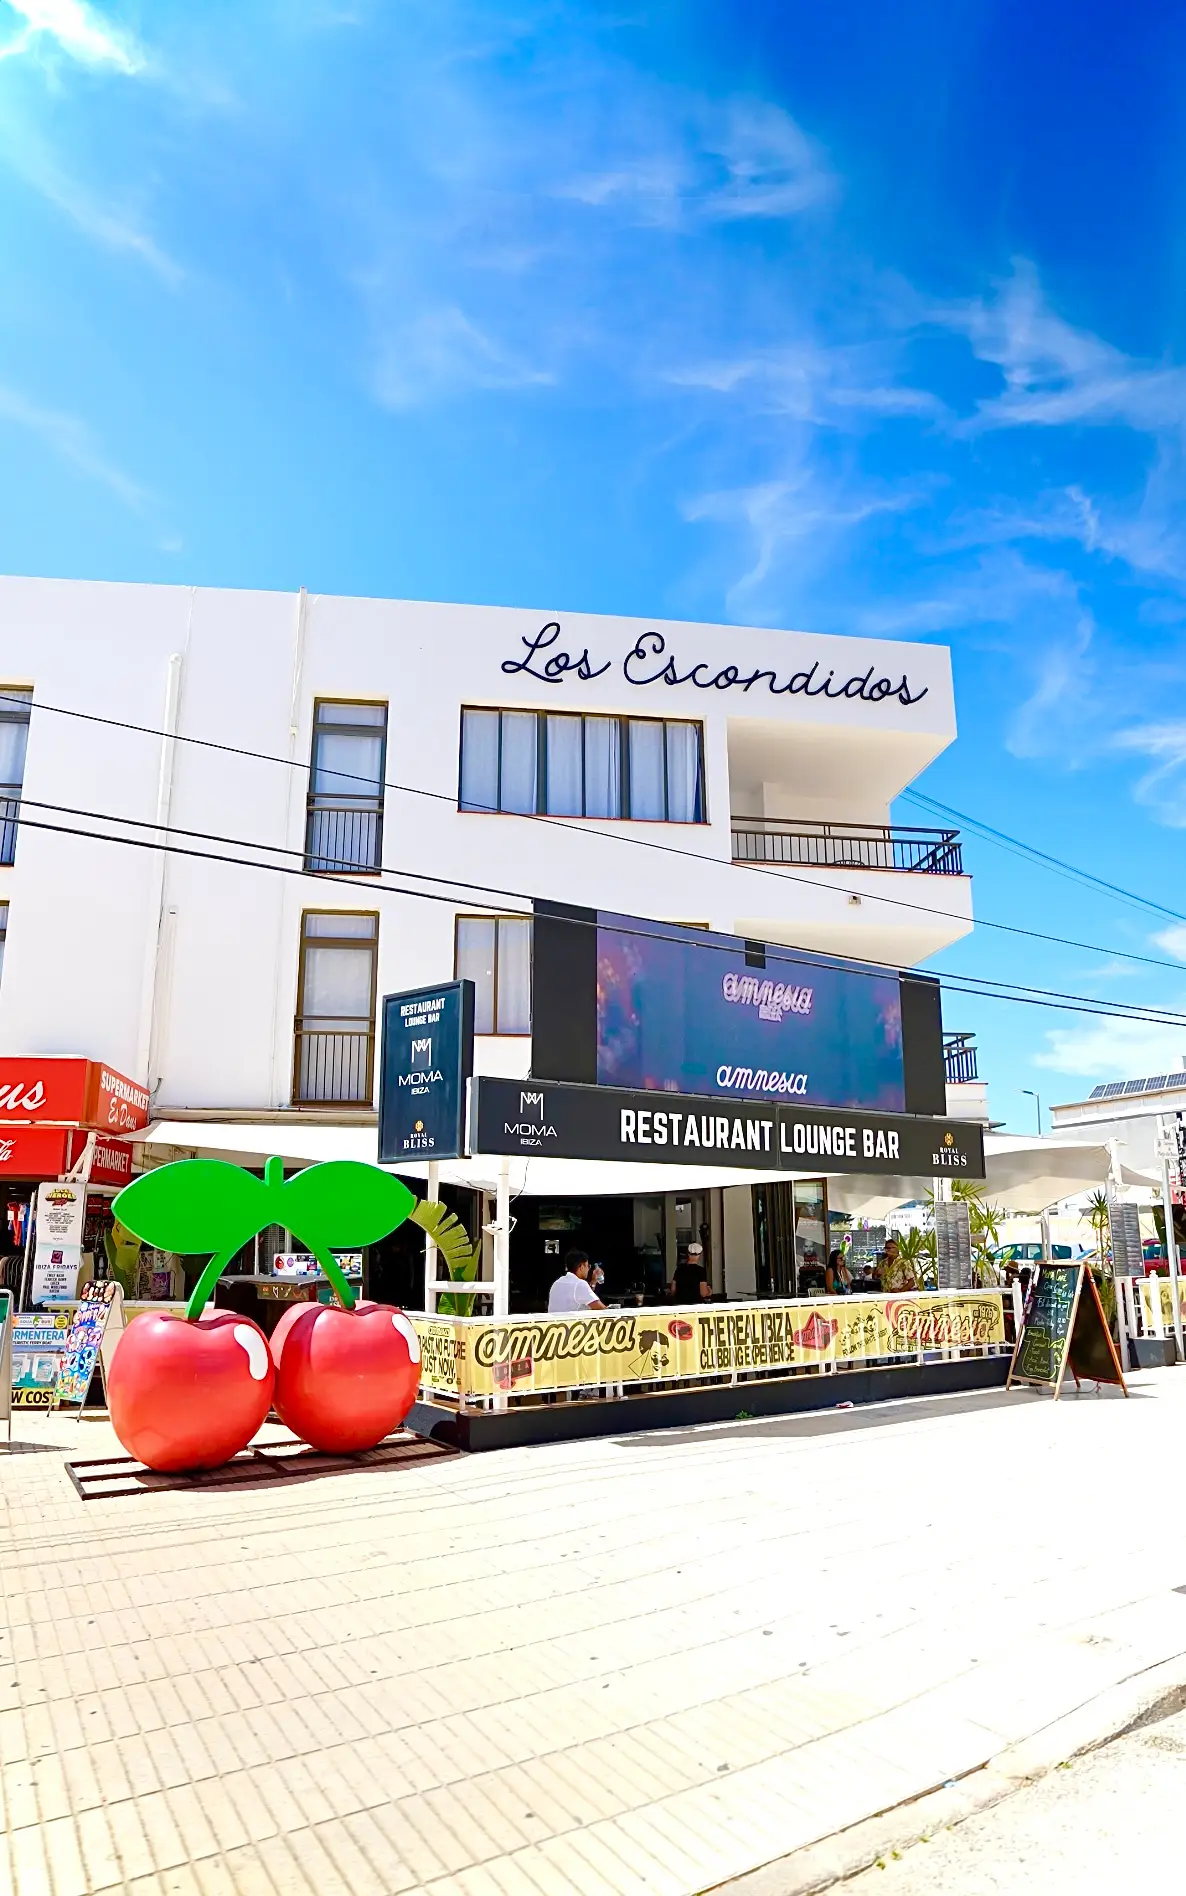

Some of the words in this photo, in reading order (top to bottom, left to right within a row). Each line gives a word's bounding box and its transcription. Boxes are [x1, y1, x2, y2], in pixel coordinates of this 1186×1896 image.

[501, 622, 611, 684] Los
[623, 631, 929, 706] Escondidos
[400, 997, 446, 1017] RESTAURANT
[404, 1014, 427, 1028] LOUNGE
[427, 1012, 440, 1024] BAR
[398, 1070, 443, 1087] MOMA
[716, 1065, 808, 1095] amnesia
[101, 1070, 150, 1111] SUPERMARKET
[410, 1086, 430, 1095] IBIZA
[504, 1123, 557, 1137] MOMA
[620, 1108, 773, 1152] RESTAURANT
[779, 1122, 857, 1157] LOUNGE
[862, 1128, 900, 1159] BAR
[403, 1137, 435, 1149] BLISS
[520, 1138, 543, 1146] IBIZA
[92, 1144, 130, 1173] PERMARKET
[932, 1153, 967, 1167] BLISS
[12, 1330, 65, 1341] RMENTERA
[698, 1316, 727, 1349] THE
[726, 1315, 760, 1348] REAL
[760, 1311, 794, 1343] IBIZA
[474, 1315, 637, 1368] amnesia
[700, 1346, 744, 1370] CLUBBING
[744, 1341, 795, 1366] EXPERIENCE
